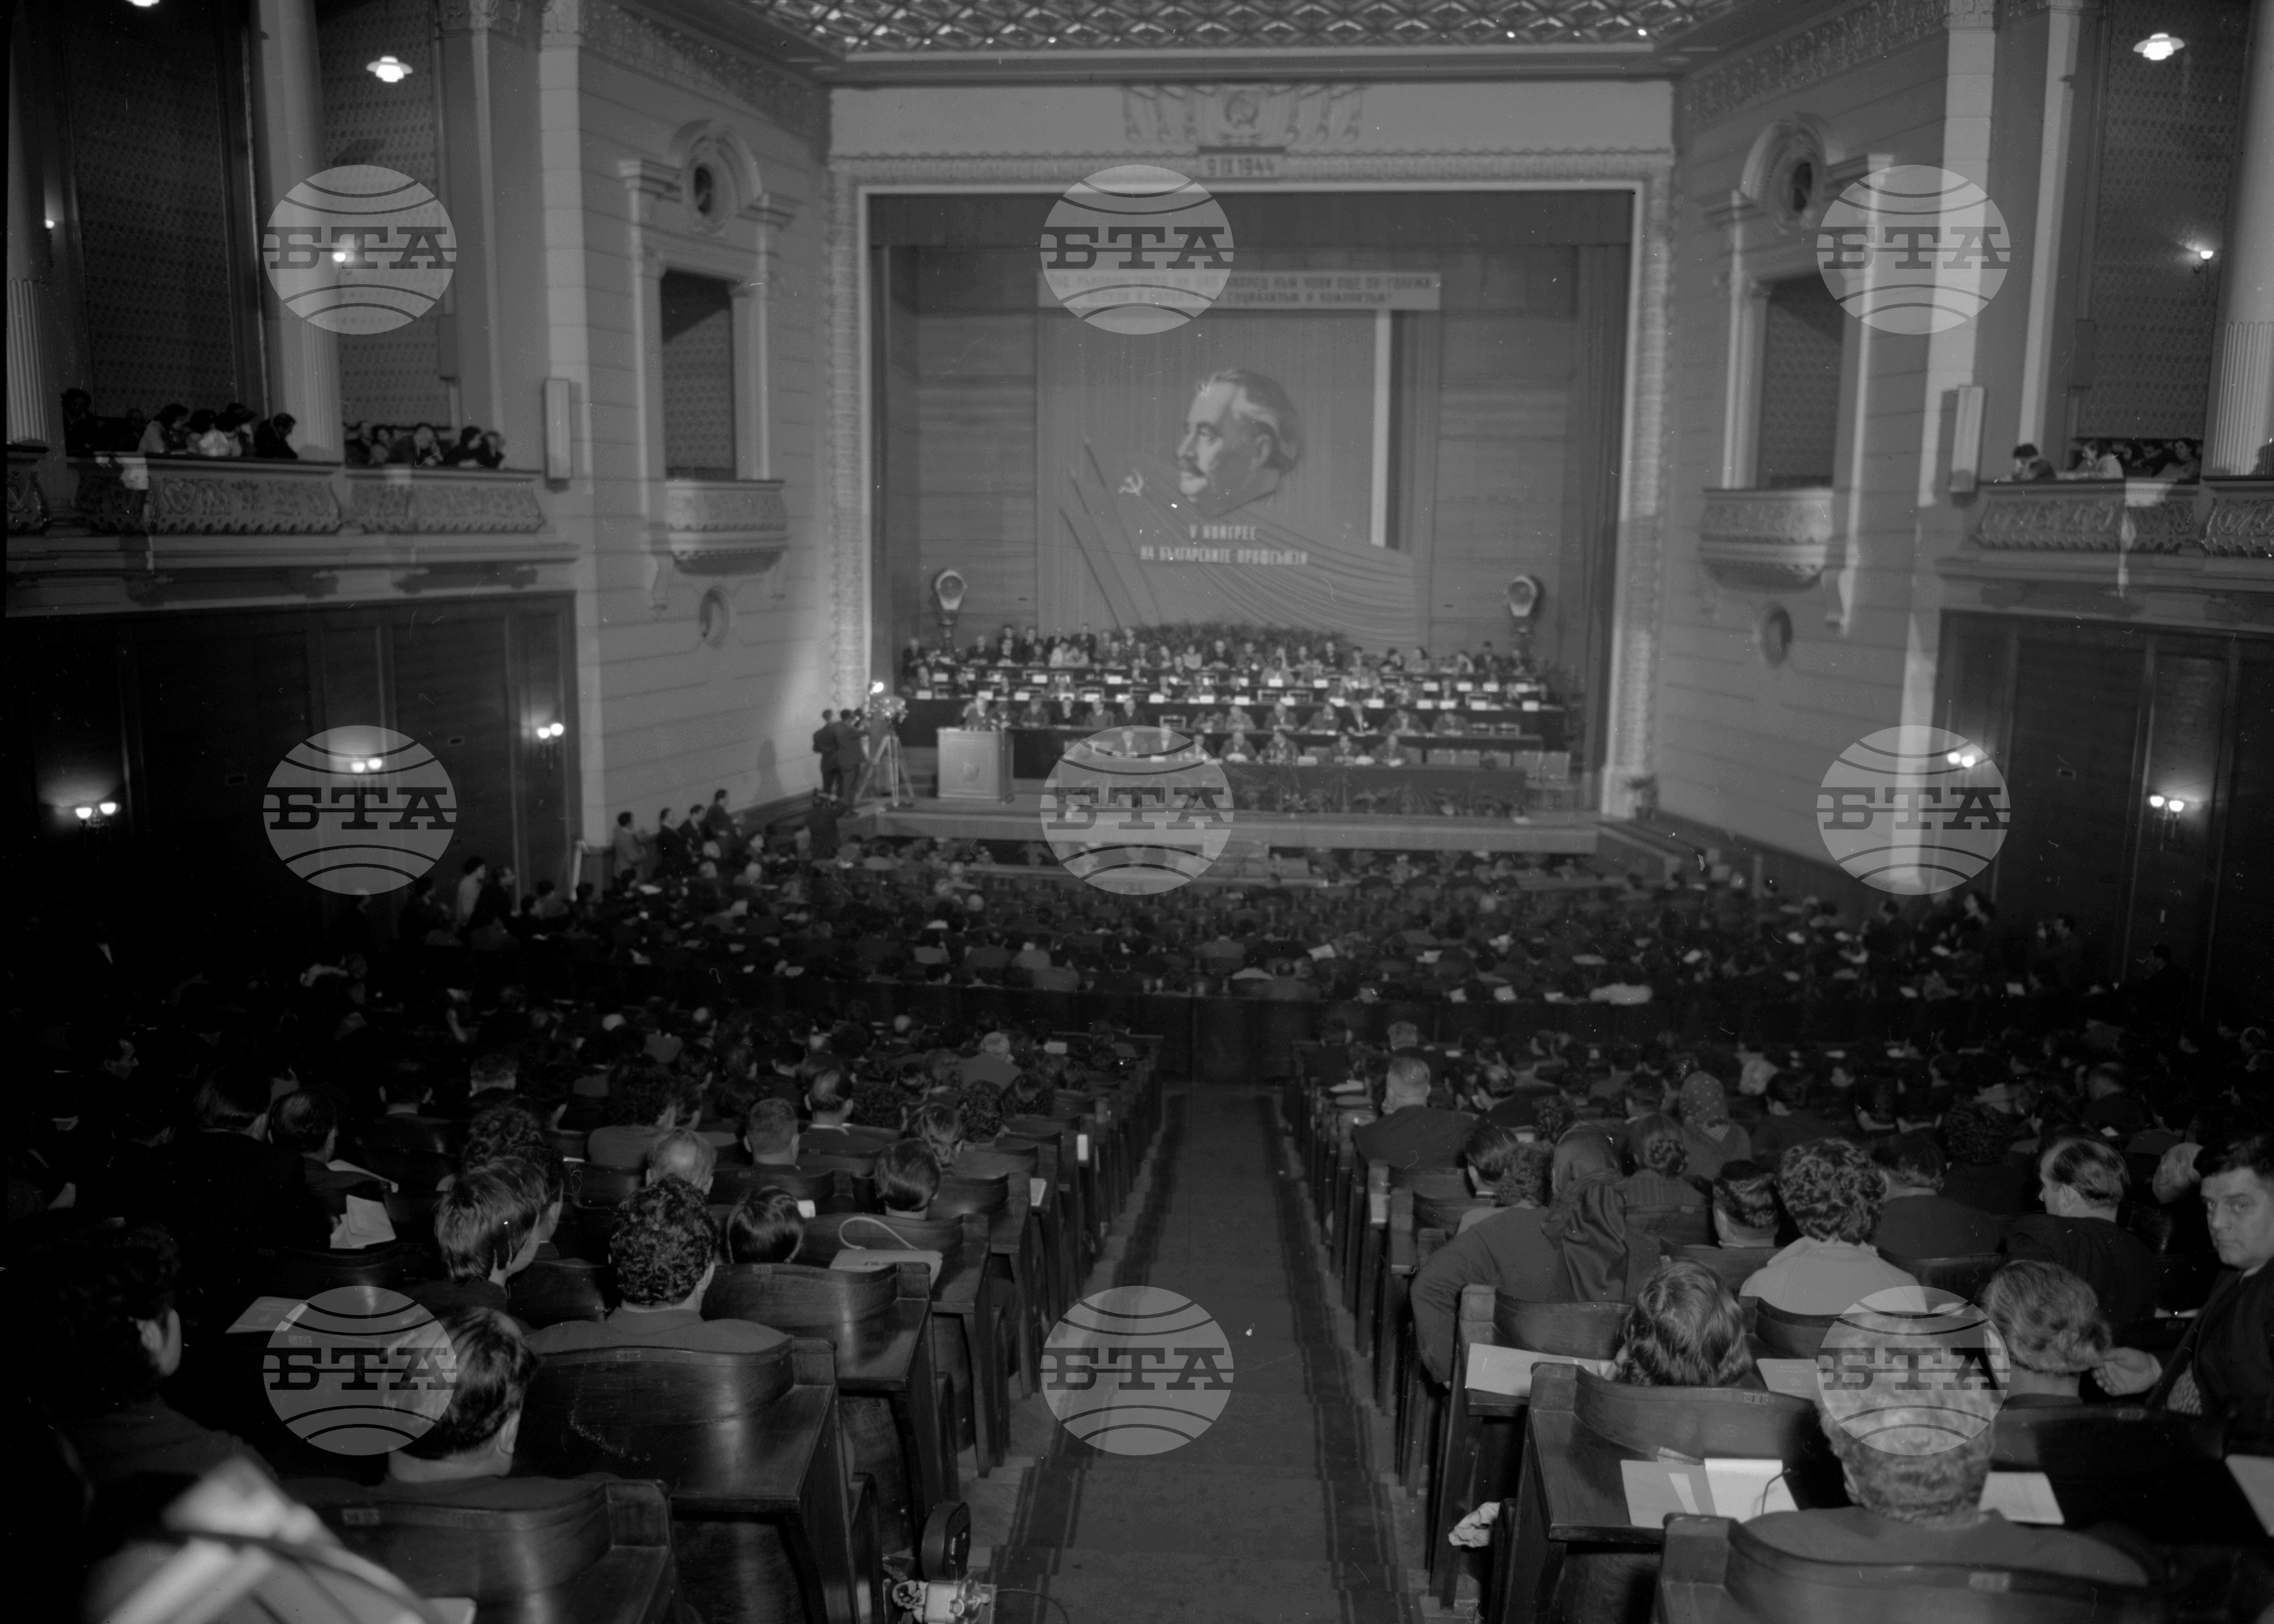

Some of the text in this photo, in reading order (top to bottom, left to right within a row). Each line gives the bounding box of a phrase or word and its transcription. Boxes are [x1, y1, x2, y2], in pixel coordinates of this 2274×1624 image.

[1189, 524, 1256, 541] V КОНГРЕС
[1140, 546, 1155, 560] НА
